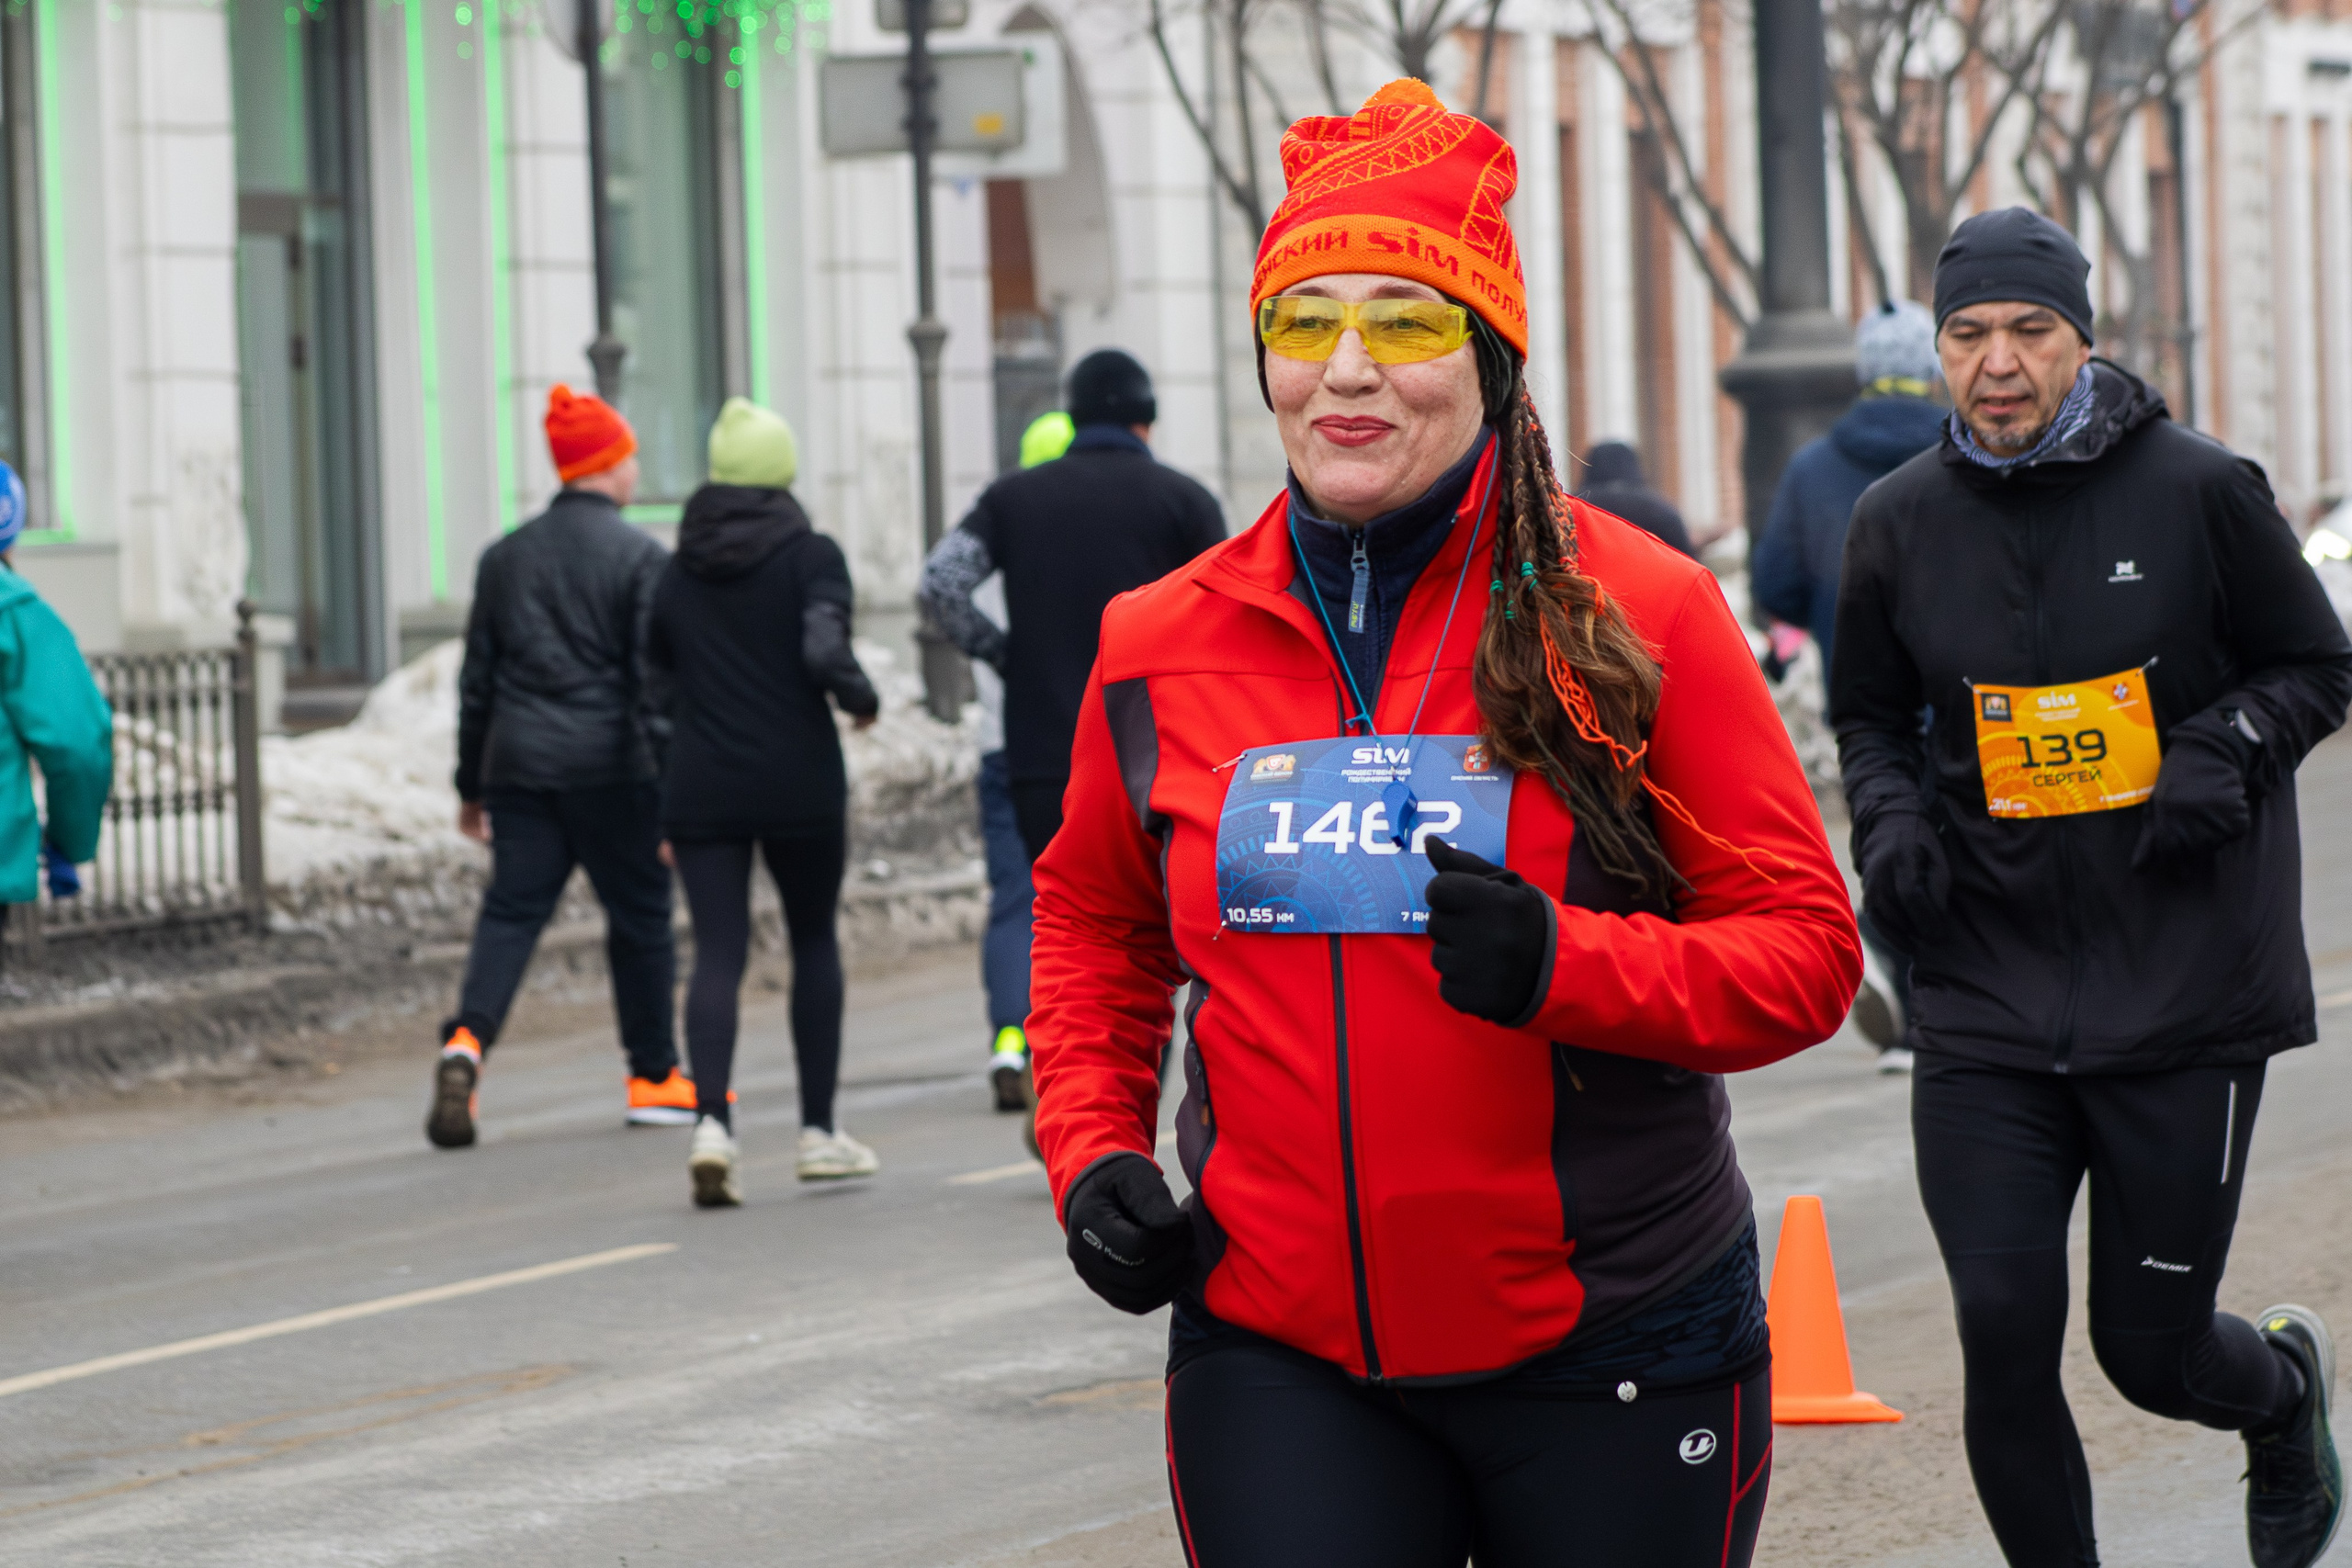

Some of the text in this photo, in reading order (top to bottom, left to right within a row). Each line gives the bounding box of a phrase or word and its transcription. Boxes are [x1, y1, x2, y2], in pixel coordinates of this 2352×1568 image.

[1471, 269, 1528, 329] ПОЛУ
[2017, 728, 2108, 768] 139
[2032, 766, 2102, 787] СЕРГЕЙ
[1263, 801, 1463, 855] 1462
[1227, 908, 1273, 924] 10,55
[1400, 911, 1430, 922] 7 ЯН
